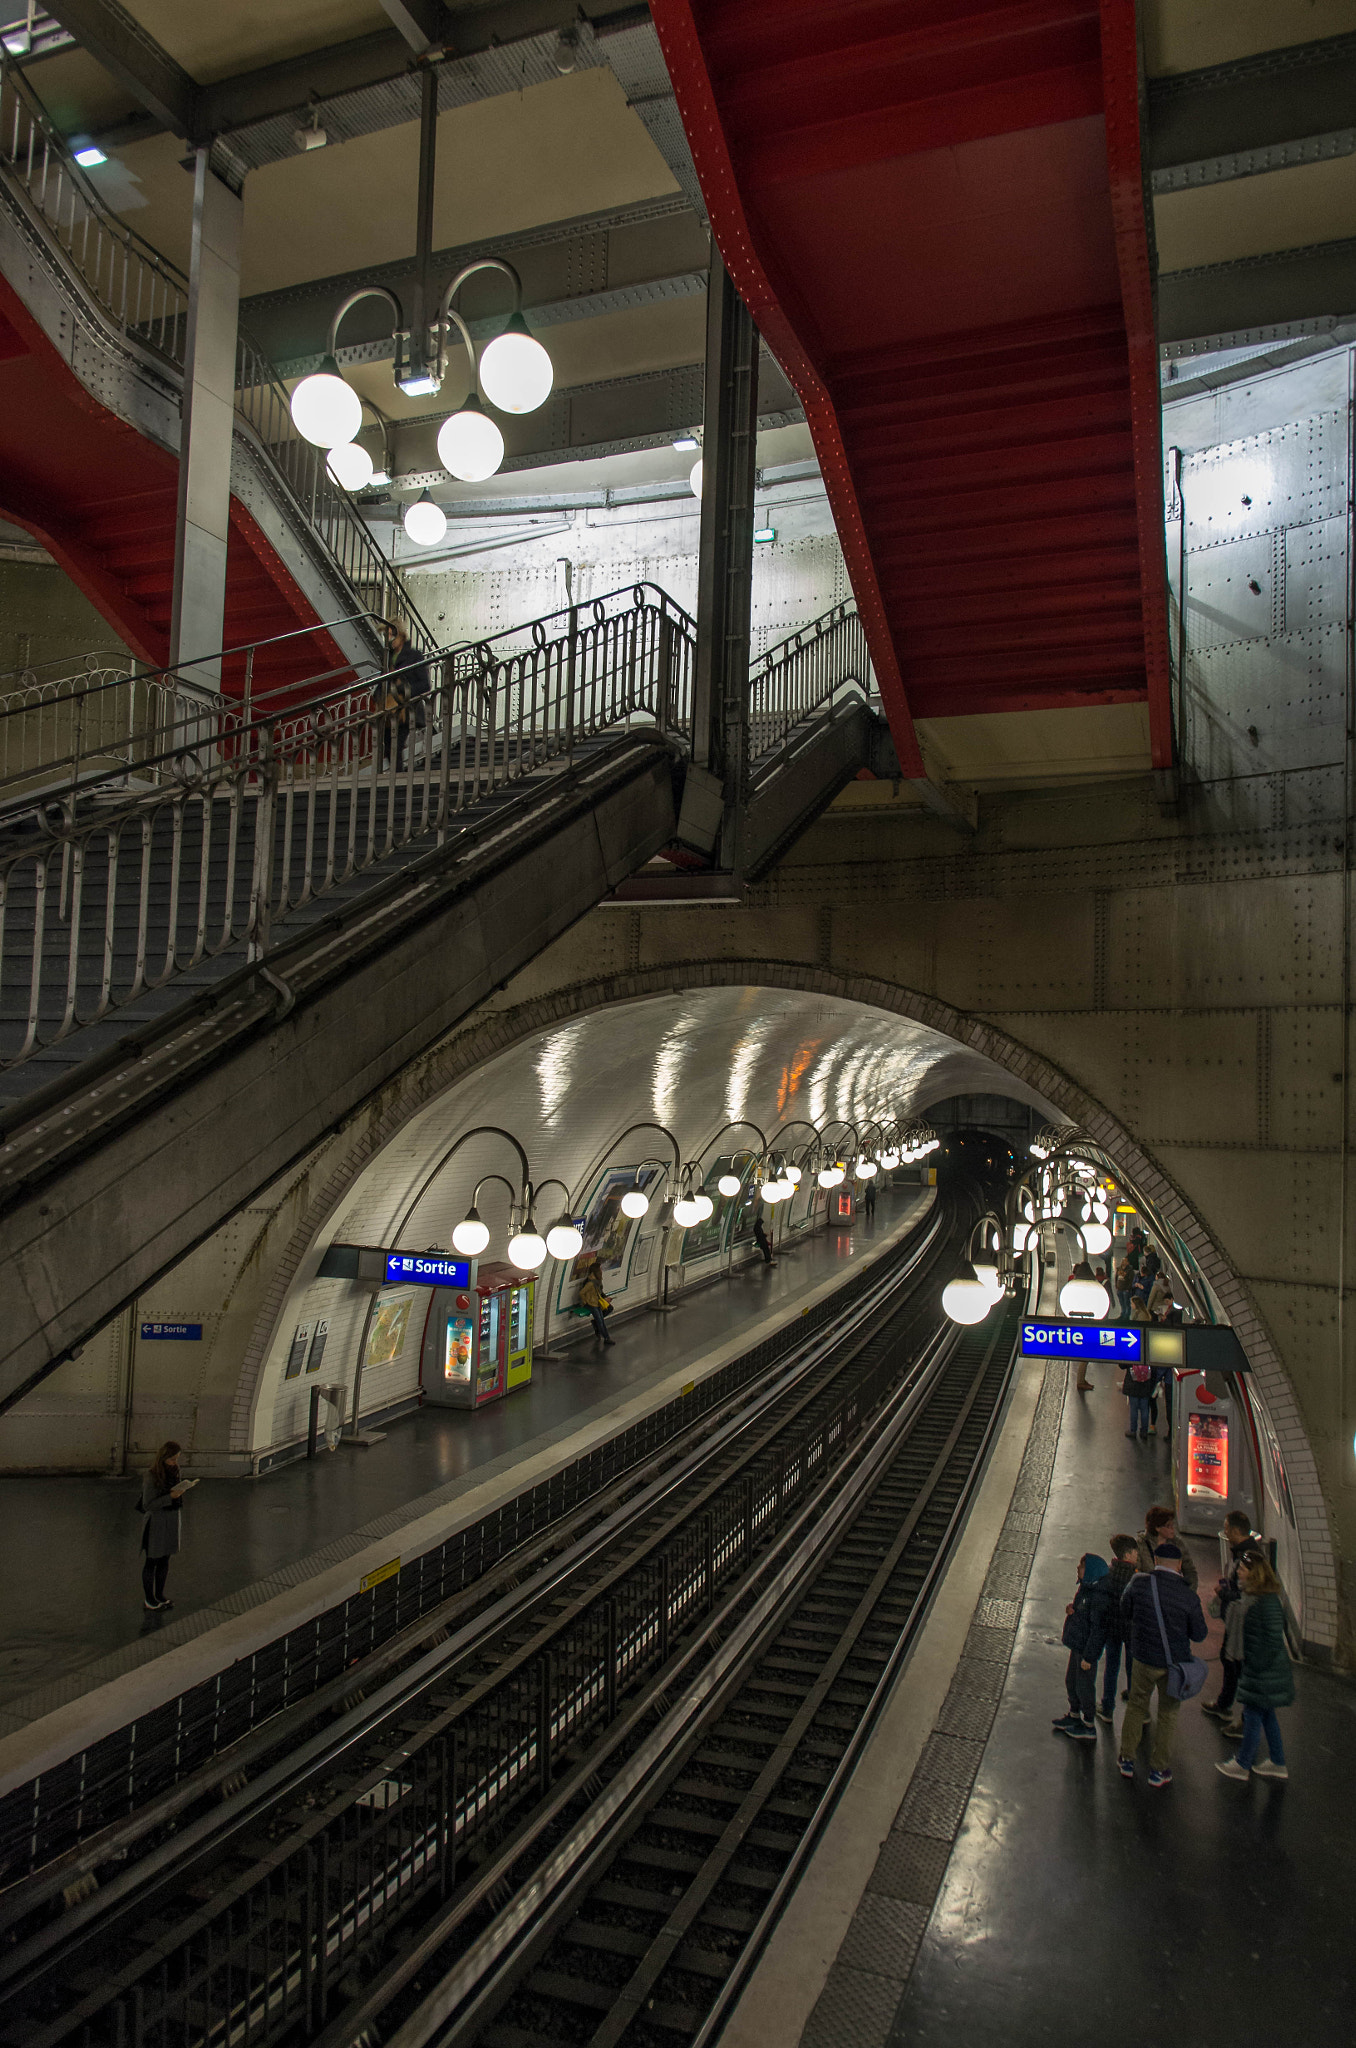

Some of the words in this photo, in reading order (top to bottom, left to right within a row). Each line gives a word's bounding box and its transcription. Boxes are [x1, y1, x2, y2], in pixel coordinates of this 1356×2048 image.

[415, 1259, 457, 1276] Sortie
[163, 1325, 188, 1334] Sortie
[1023, 1325, 1084, 1346] Sortie
